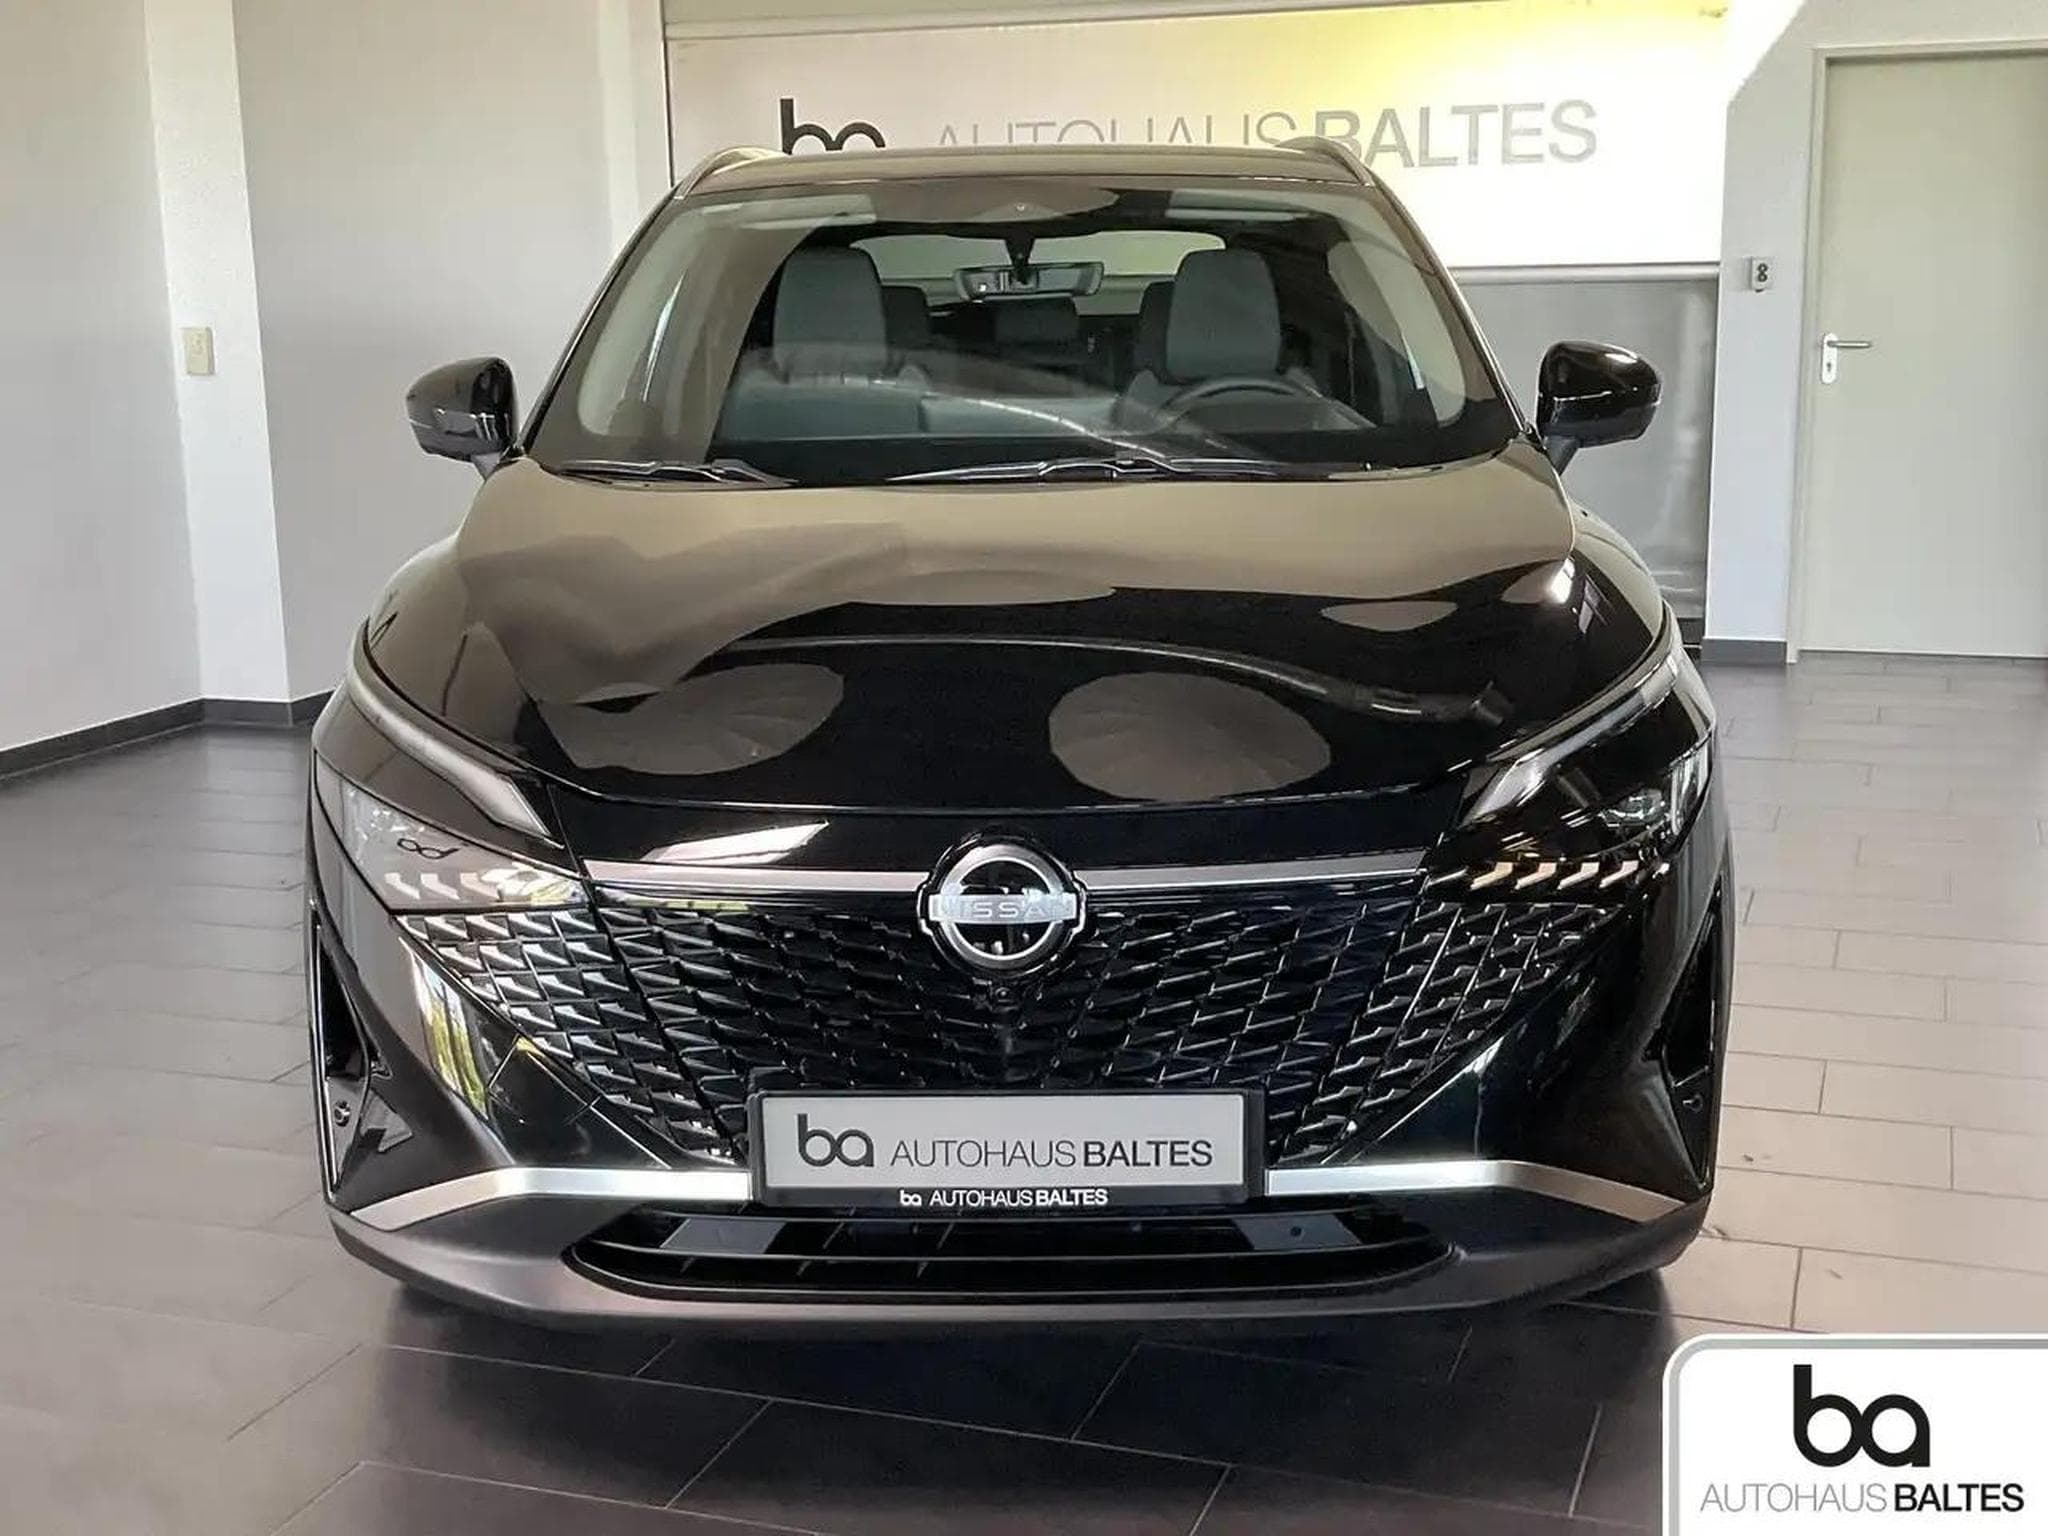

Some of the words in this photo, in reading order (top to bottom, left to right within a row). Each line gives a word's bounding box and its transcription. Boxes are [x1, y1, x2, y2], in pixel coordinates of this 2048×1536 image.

[797, 1113, 874, 1168] ba
[890, 1139, 1077, 1168] AUTOHAUS
[1083, 1139, 1213, 1168] BALTES
[900, 1189, 922, 1206] ba
[929, 1189, 1034, 1207] AUTOHAUS
[1036, 1188, 1108, 1206] BALTES
